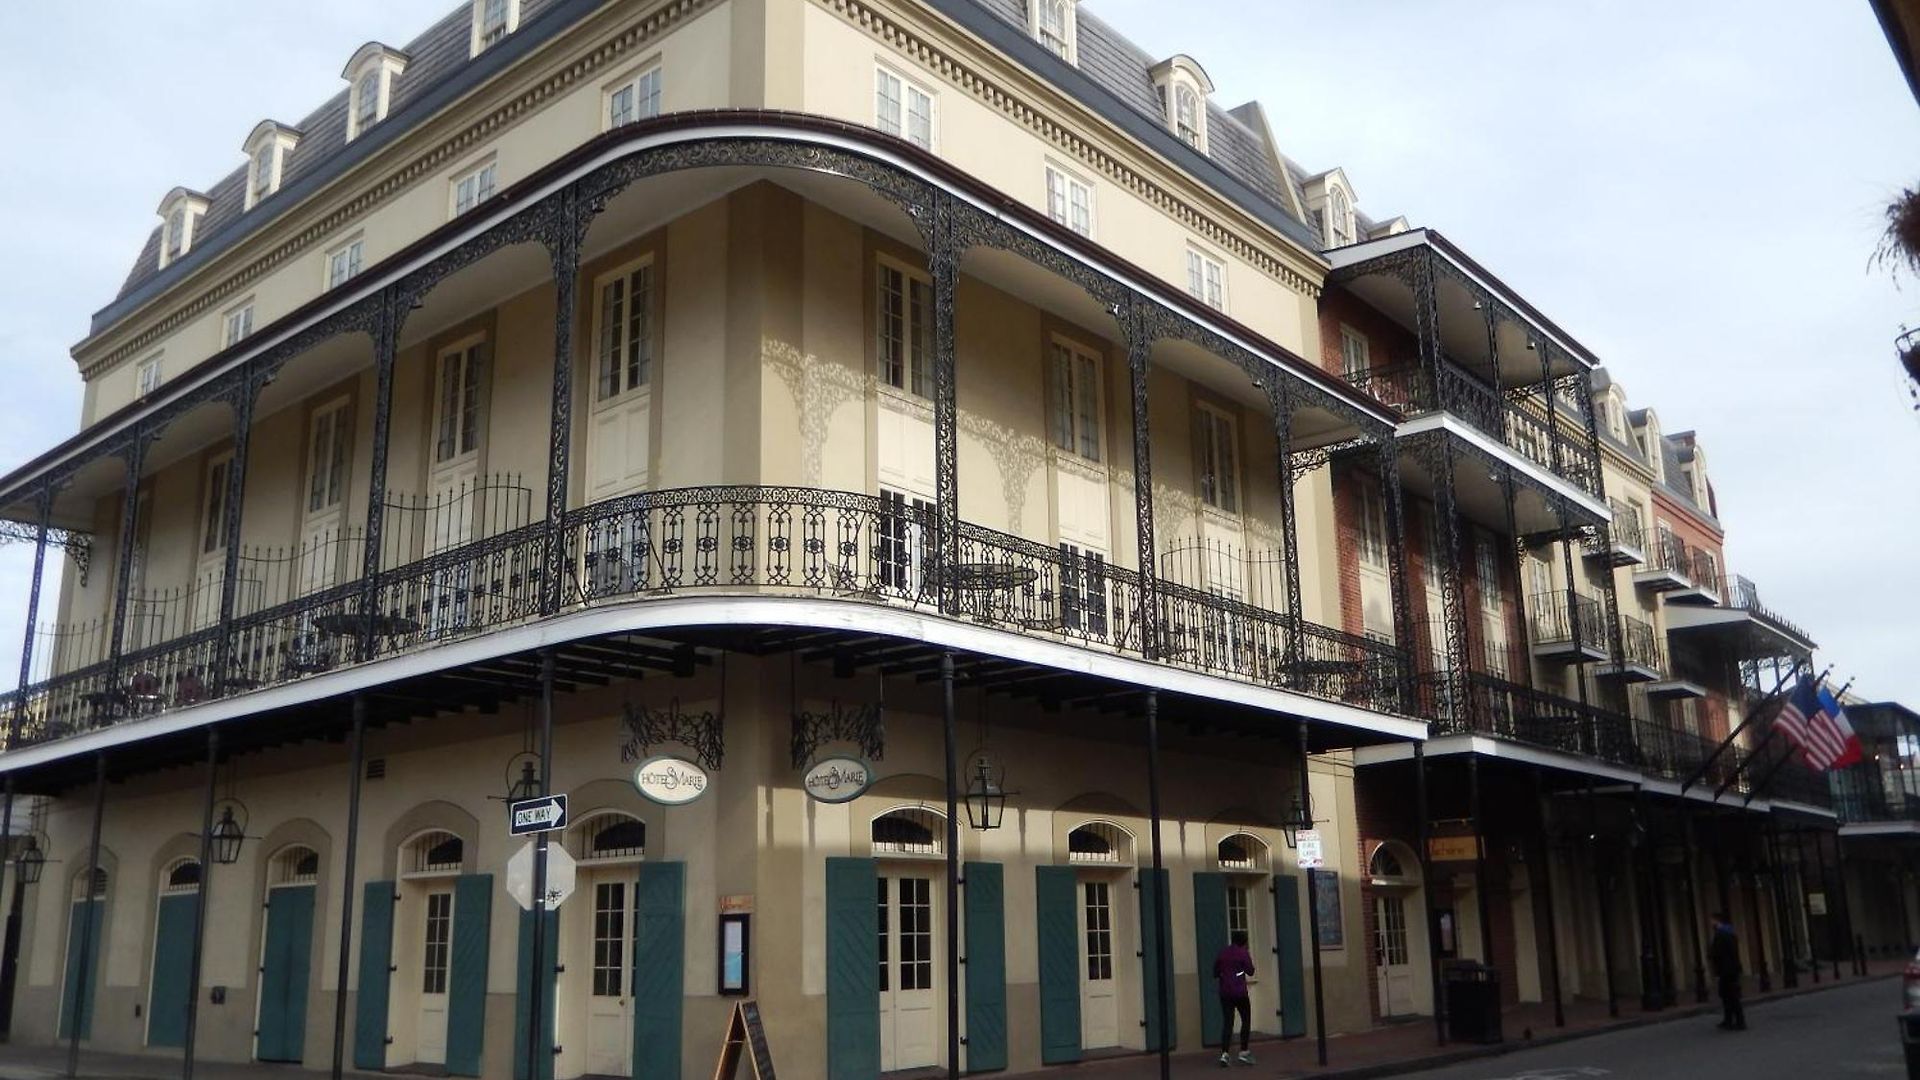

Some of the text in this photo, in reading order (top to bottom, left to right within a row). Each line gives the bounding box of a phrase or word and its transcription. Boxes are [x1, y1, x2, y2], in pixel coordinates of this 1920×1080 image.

[676, 771, 702, 791] MARIE
[838, 770, 864, 786] MARIE
[517, 807, 551, 824] ONE WAY
